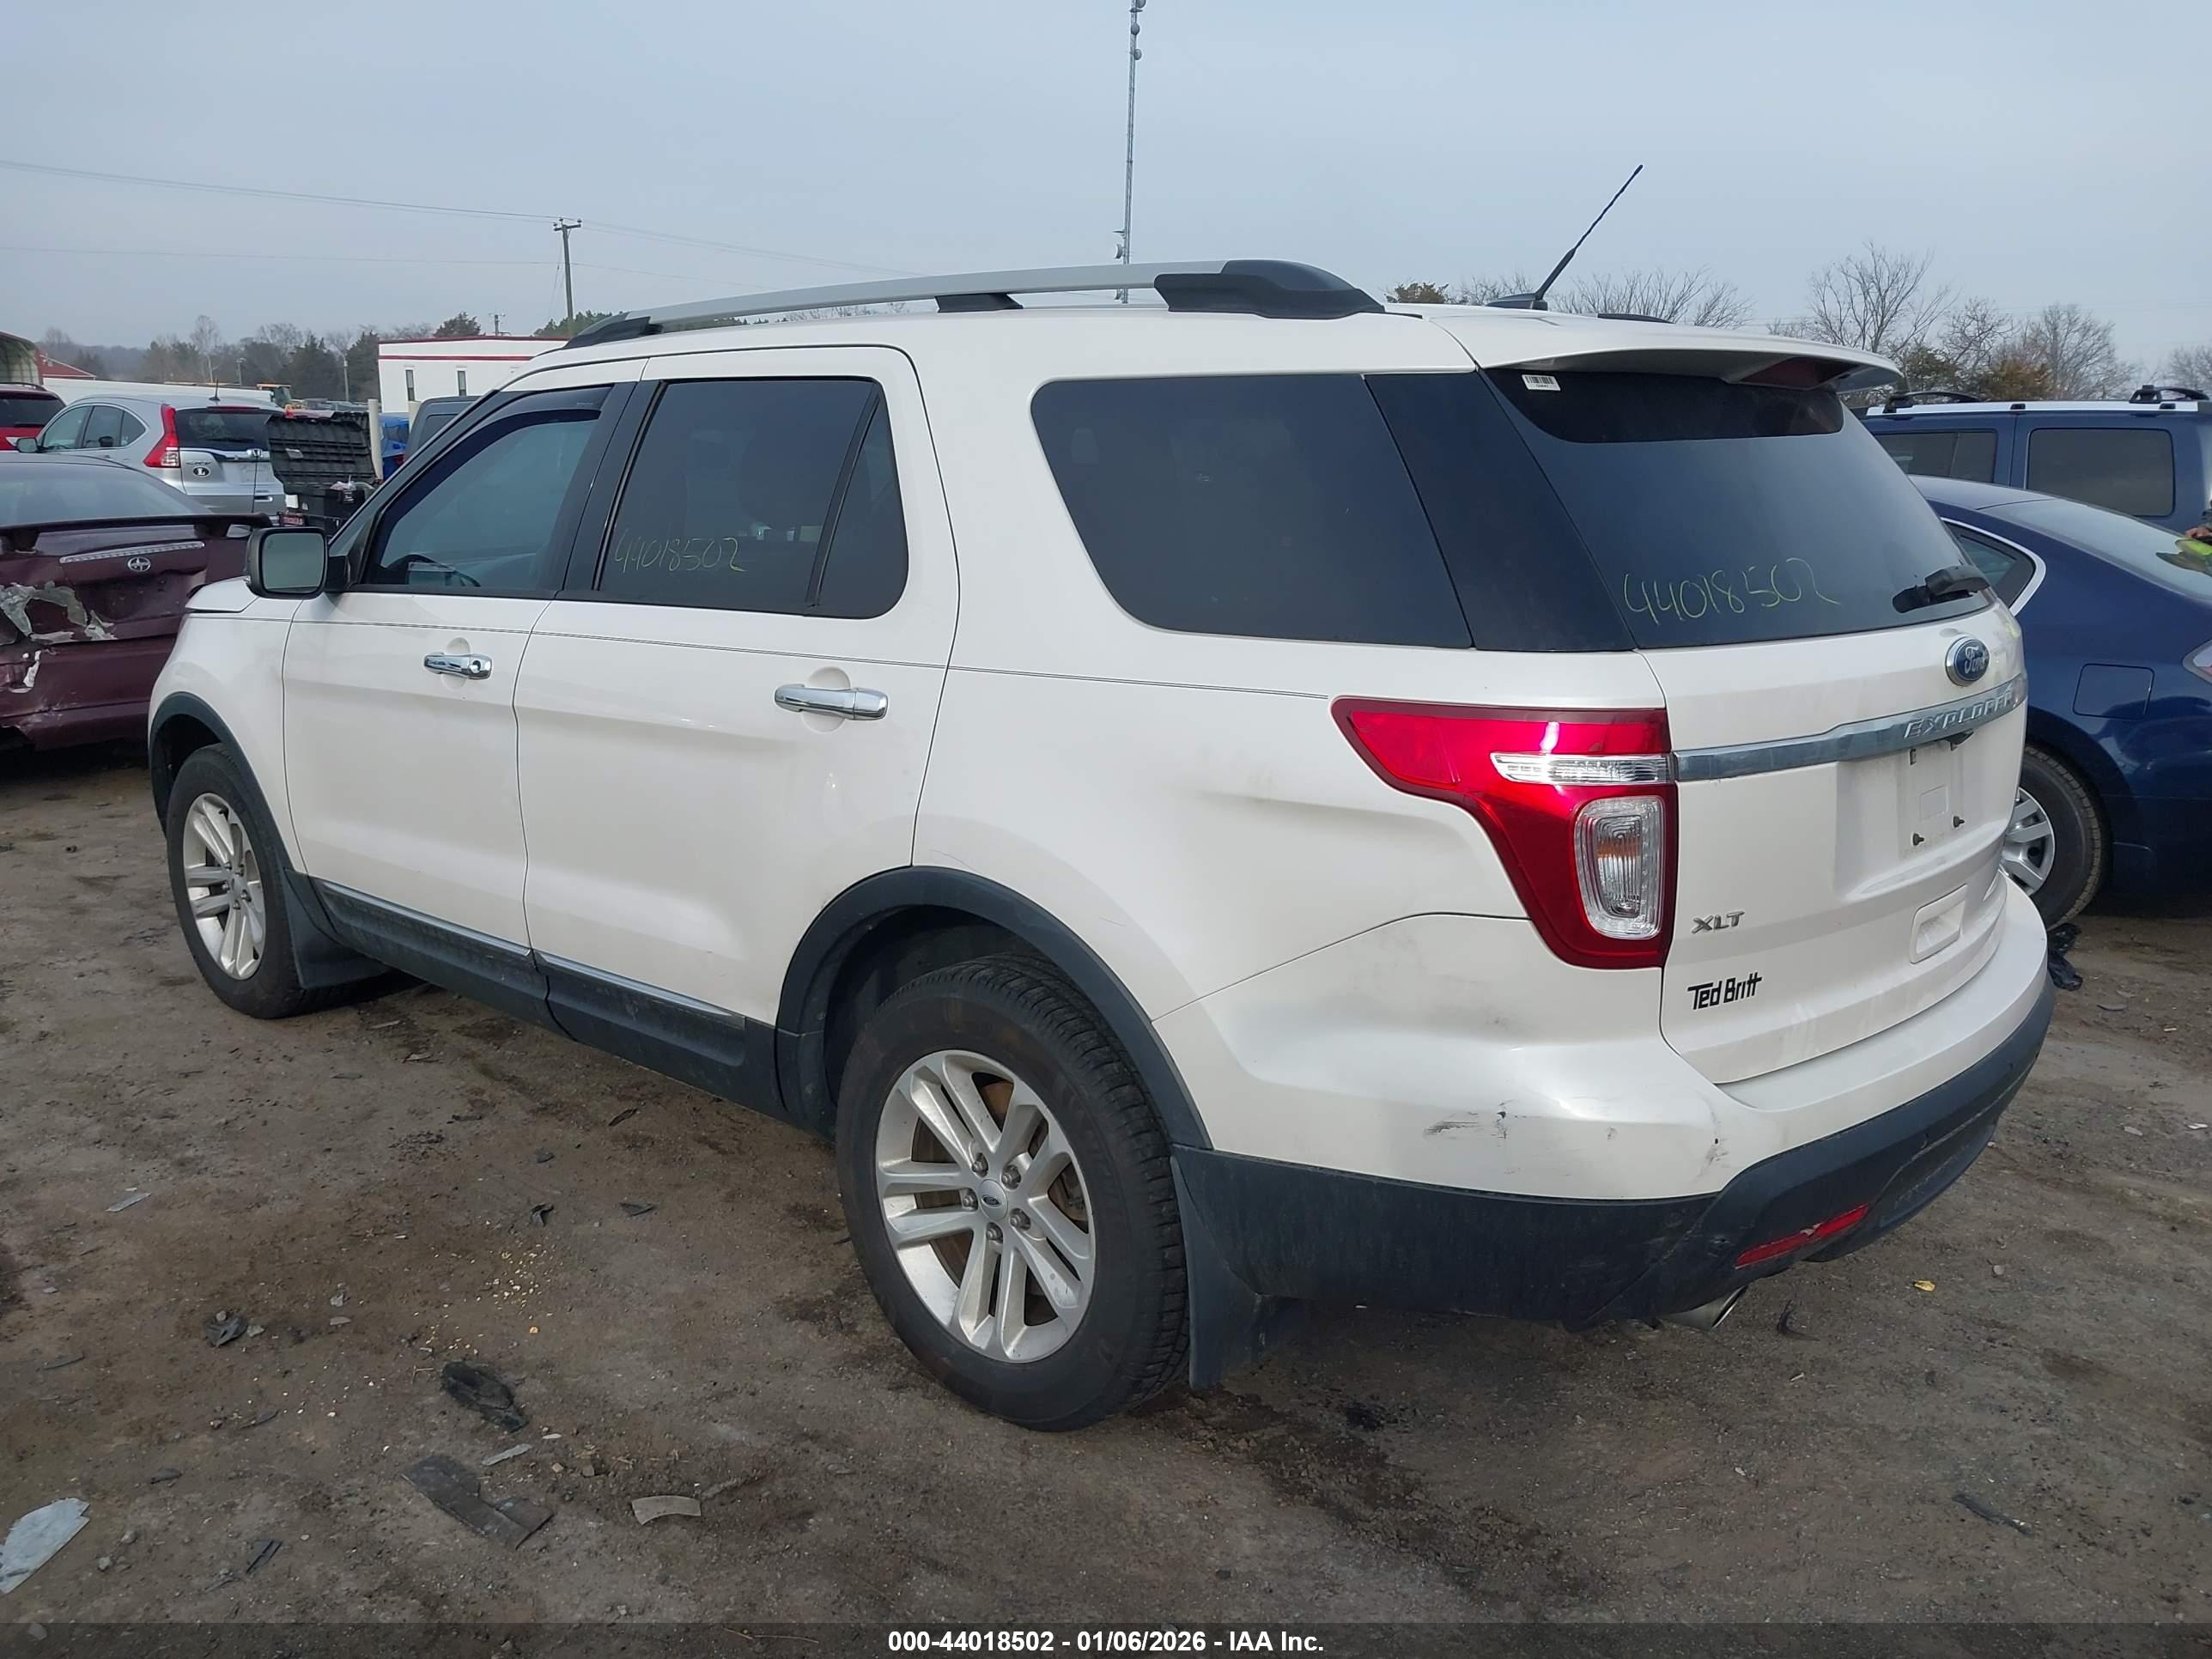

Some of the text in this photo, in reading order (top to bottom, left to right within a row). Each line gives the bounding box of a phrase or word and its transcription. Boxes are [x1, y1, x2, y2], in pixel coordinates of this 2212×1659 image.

[614, 530, 747, 574] 44018502
[1622, 557, 1841, 626] 44018502
[1965, 646, 1990, 674] Ford
[1692, 911, 1745, 934] XLT
[1687, 972, 1762, 1010] Ted Britt
